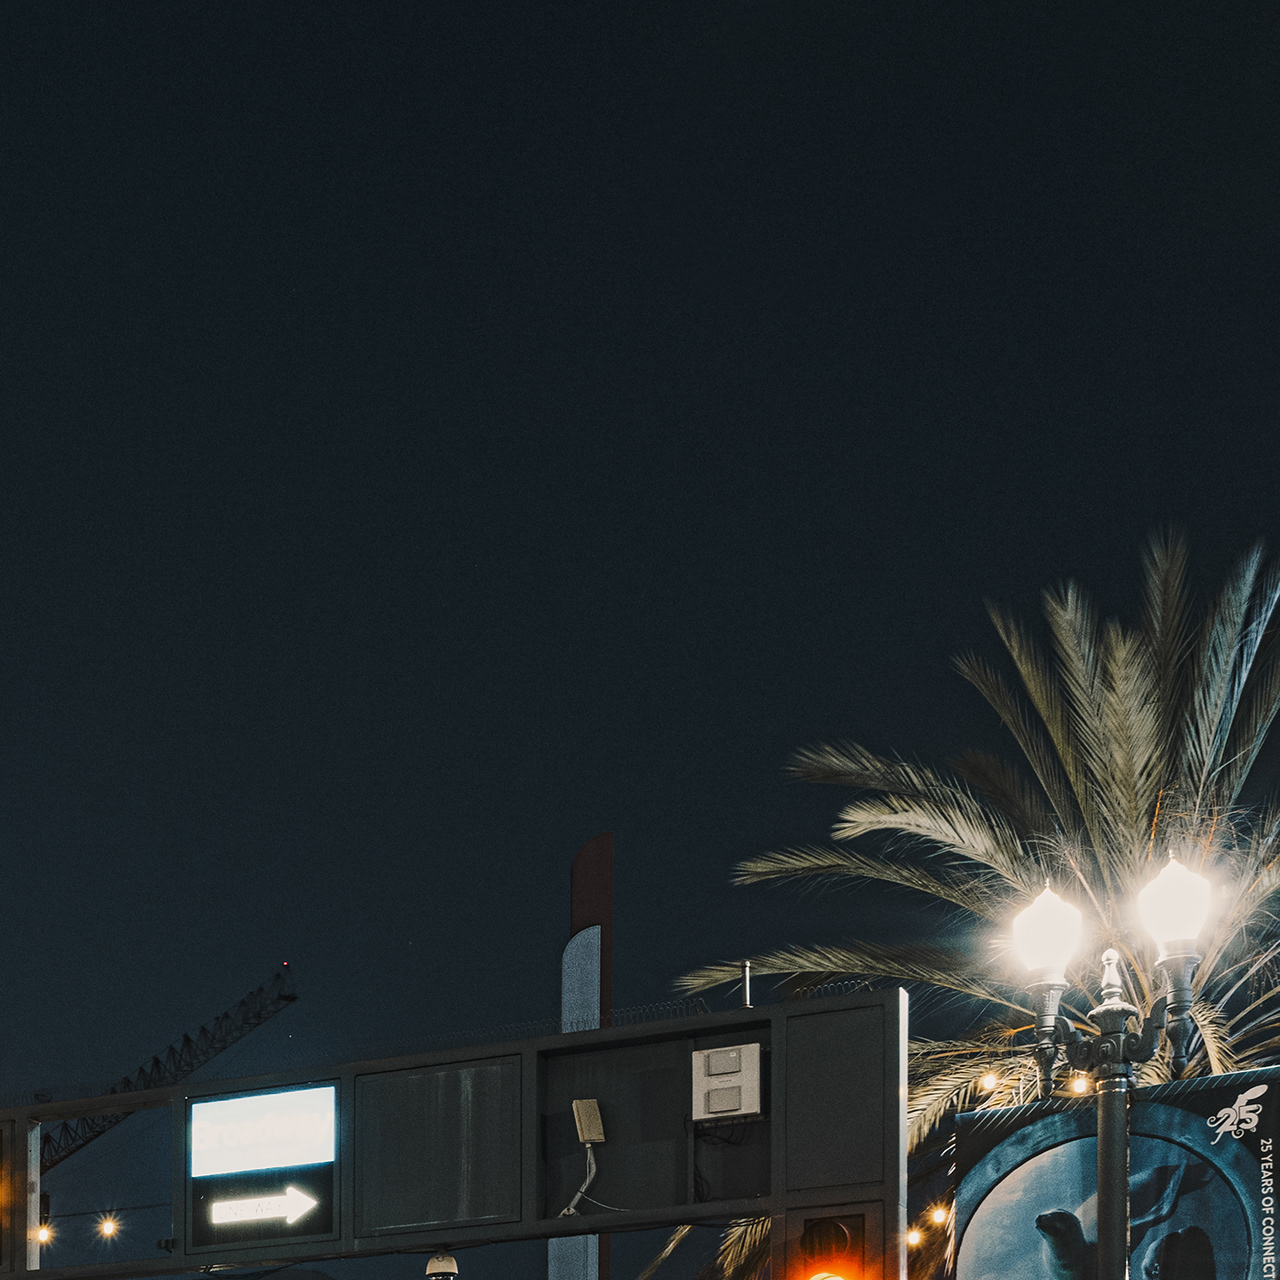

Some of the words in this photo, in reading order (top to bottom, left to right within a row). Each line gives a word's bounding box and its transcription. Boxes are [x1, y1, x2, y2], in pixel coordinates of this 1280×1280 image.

[1215, 1103, 1262, 1133] 25
[1260, 1138, 1273, 1152] 25
[1260, 1154, 1273, 1194] YEARS
[1261, 1196, 1274, 1214] OF
